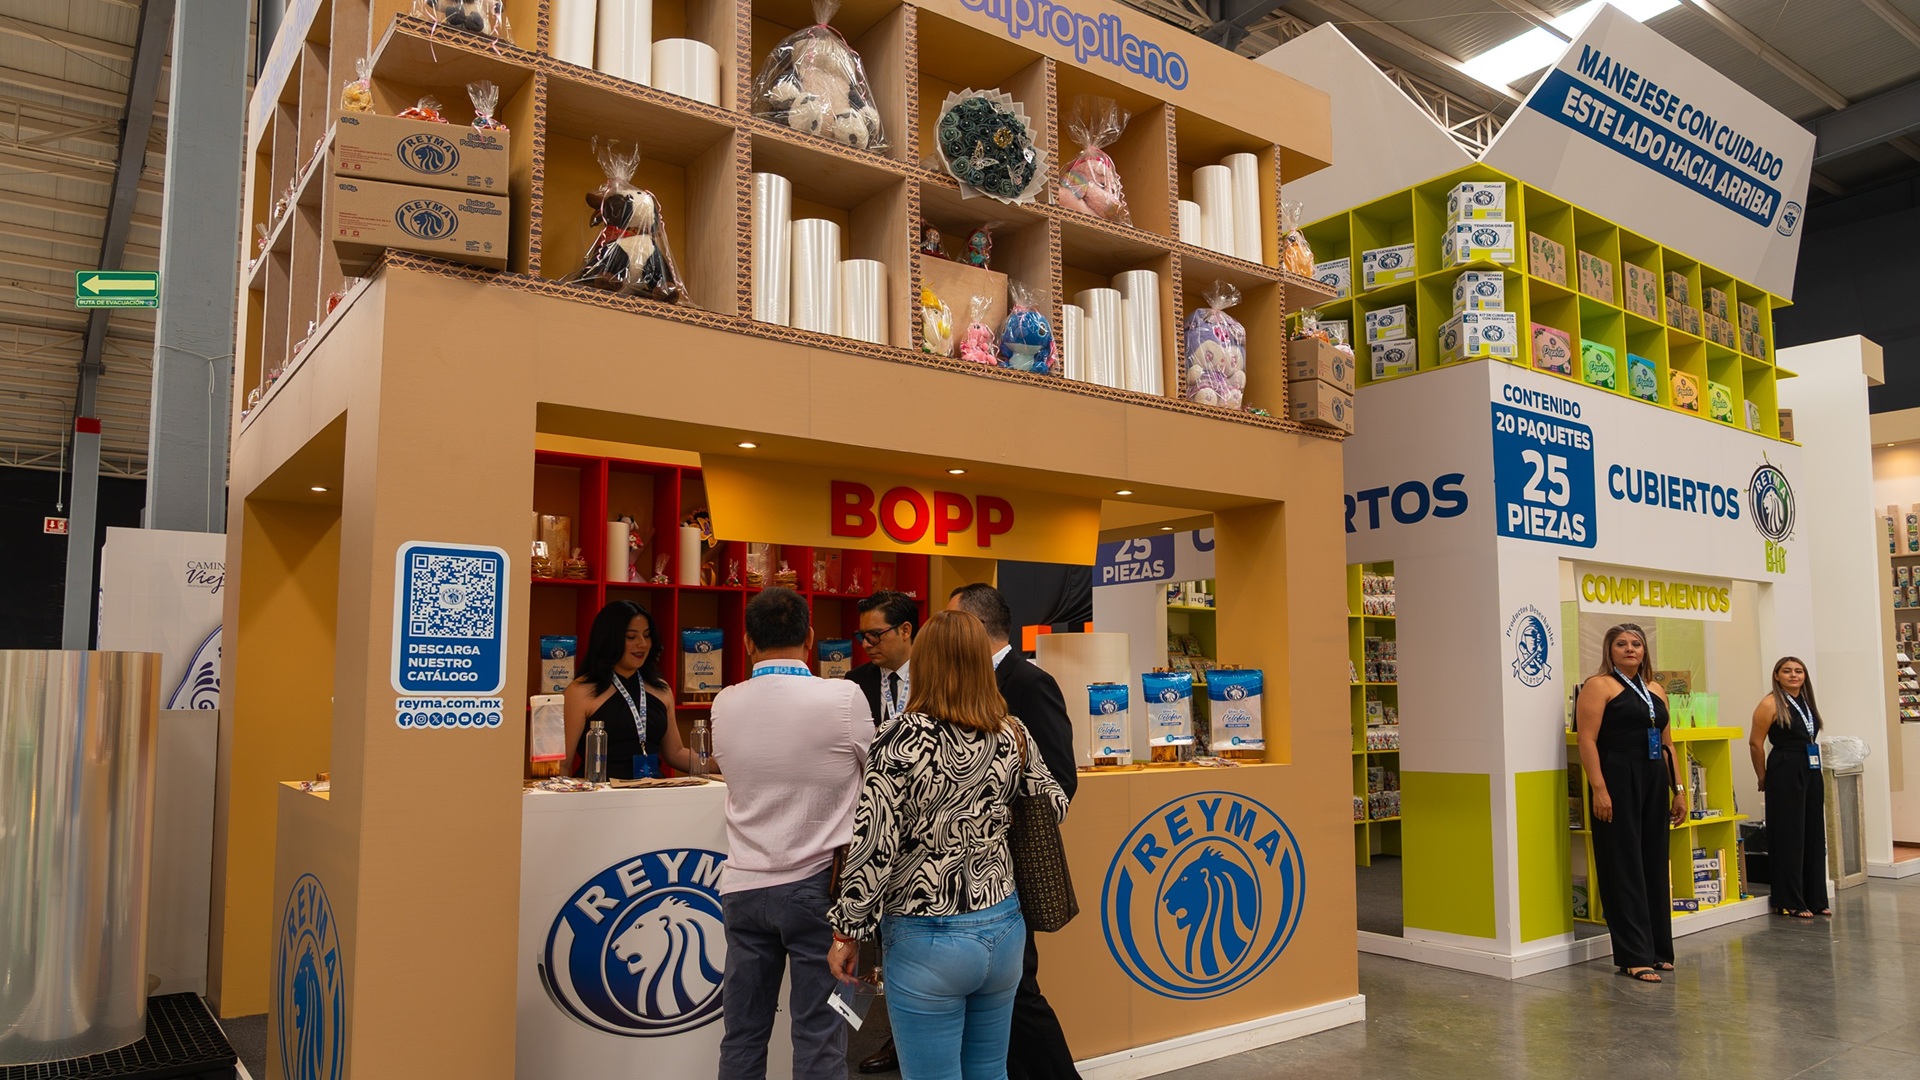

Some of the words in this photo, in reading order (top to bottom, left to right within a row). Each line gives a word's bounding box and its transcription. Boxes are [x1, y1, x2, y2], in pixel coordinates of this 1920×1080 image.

[960, 0, 1188, 90] propileno
[1576, 44, 1680, 123] MANEJESE
[1677, 103, 1718, 144] CON
[1714, 125, 1783, 182] CUIDADO
[406, 135, 452, 153] REYMA
[1561, 86, 1617, 136] ESTE
[1612, 114, 1666, 161] LADO
[1663, 141, 1718, 190] HACIA
[1714, 171, 1774, 220] ARRIBA
[405, 200, 451, 219] REYMA
[1503, 384, 1581, 419] CONTENIDO
[1495, 411, 1515, 434] 20
[1517, 416, 1591, 451] PAQUETES
[1521, 449, 1571, 507] 25
[1608, 464, 1740, 520] CUBIERTOS
[1755, 471, 1787, 499] REYMA
[830, 480, 1015, 548] BOPP
[1507, 502, 1586, 542] PIEZAS
[187, 560, 226, 571] CAMIN
[1115, 537, 1152, 563] 25
[186, 569, 225, 594] Viej
[1102, 559, 1165, 583] PIEZAS
[1581, 573, 1730, 613] COMPLEMENTOS
[1506, 605, 1529, 638] Productos
[1529, 604, 1554, 647] Desechables
[408, 657, 472, 668] NUESTRO
[409, 643, 481, 656] DESCARGA
[407, 669, 479, 682] CATÁLOGO
[398, 698, 501, 711] reyma.com.mx
[1131, 798, 1281, 875] REYMA
[574, 851, 726, 925] REYM
[288, 882, 337, 996] REYMA
